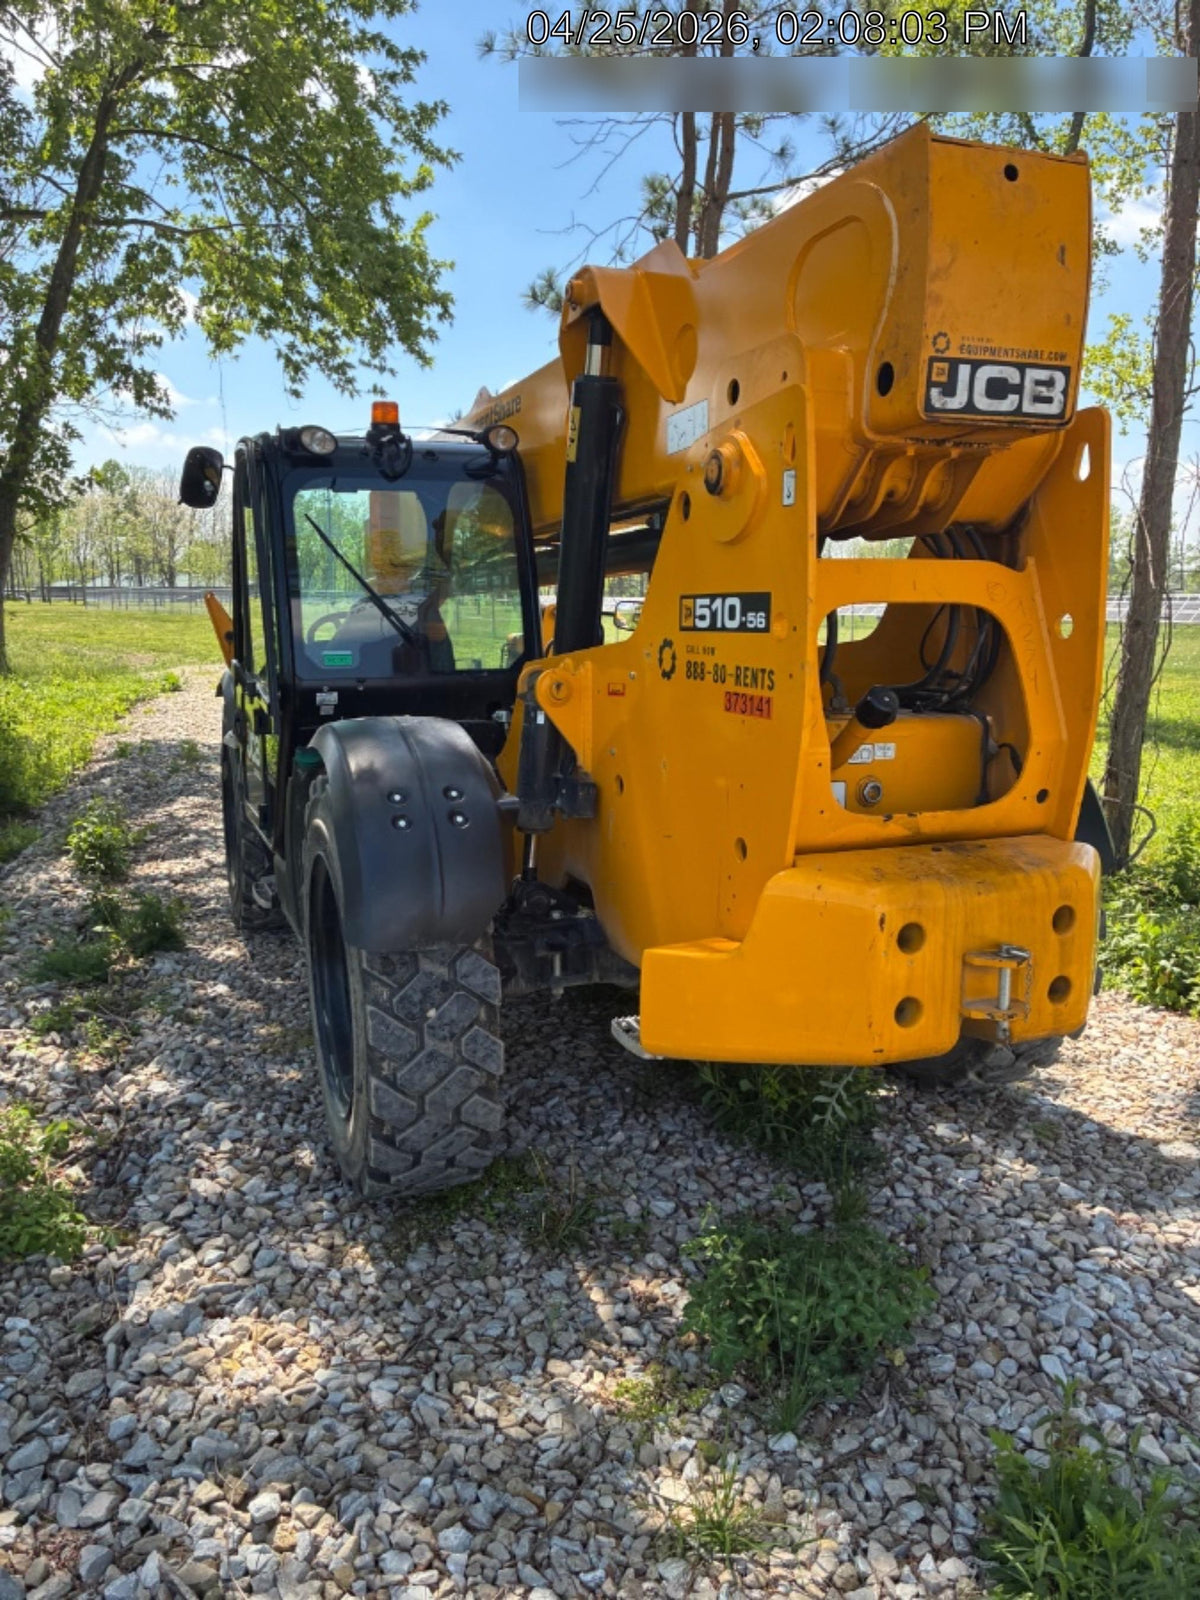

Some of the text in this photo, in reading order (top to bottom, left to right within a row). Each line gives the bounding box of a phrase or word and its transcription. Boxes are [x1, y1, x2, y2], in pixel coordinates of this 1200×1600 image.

[930, 364, 1066, 415] JCB
[694, 596, 766, 629] 510-56
[685, 660, 775, 691] 888-80-RENTS
[724, 691, 771, 719] 373141
